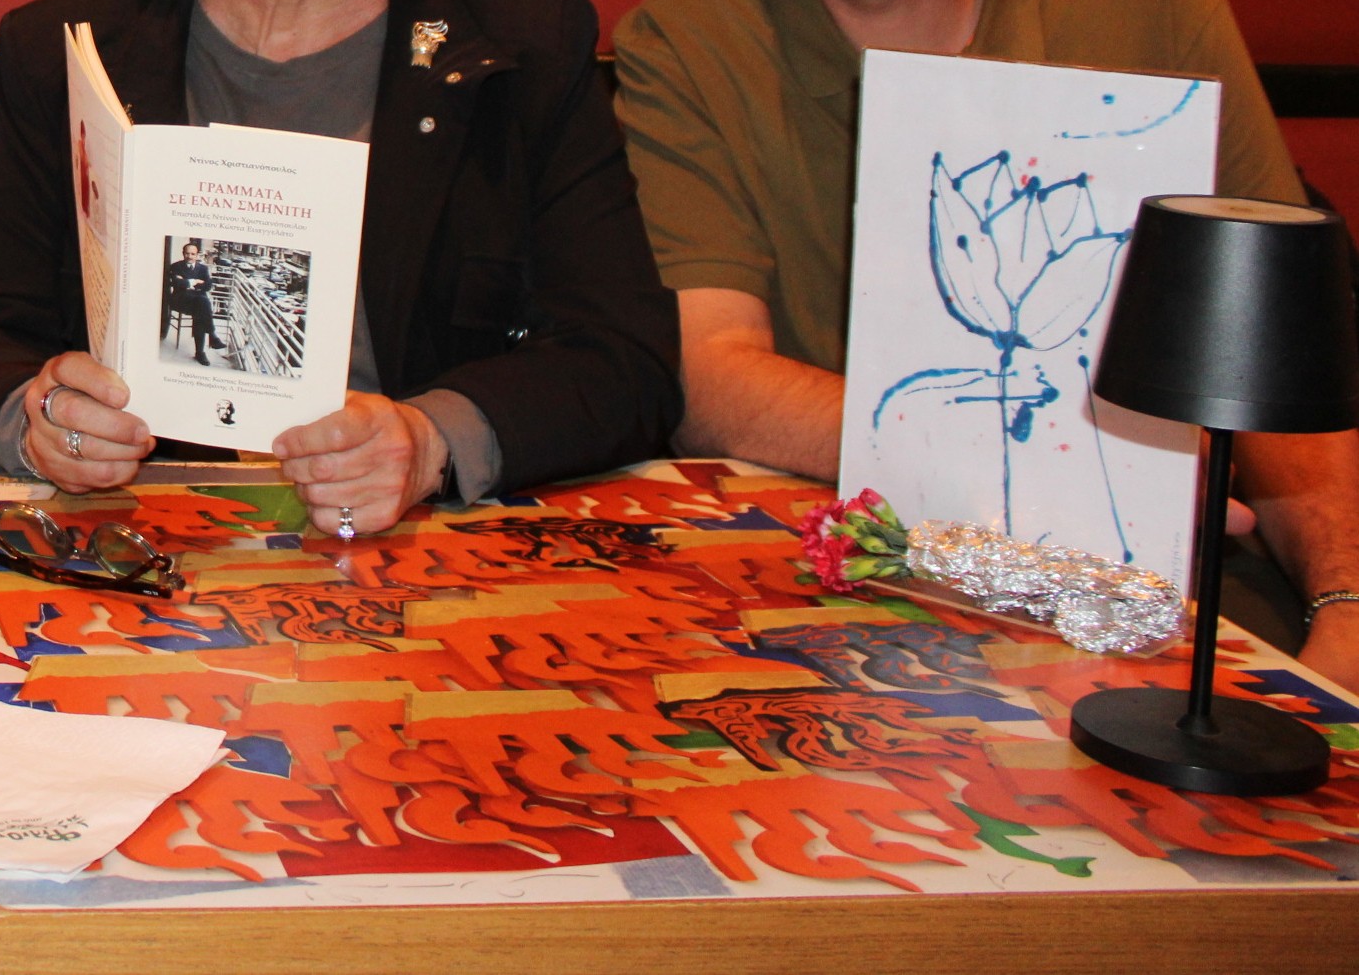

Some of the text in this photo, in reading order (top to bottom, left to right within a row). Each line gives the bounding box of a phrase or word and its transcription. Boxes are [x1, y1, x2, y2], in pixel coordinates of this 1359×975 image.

[198, 181, 284, 201] ΓΡΑΜΜΑΤΑ
[168, 193, 313, 219] ΣΕ ΕΝΑΝ ΣΜΗΝΙΤΗ
